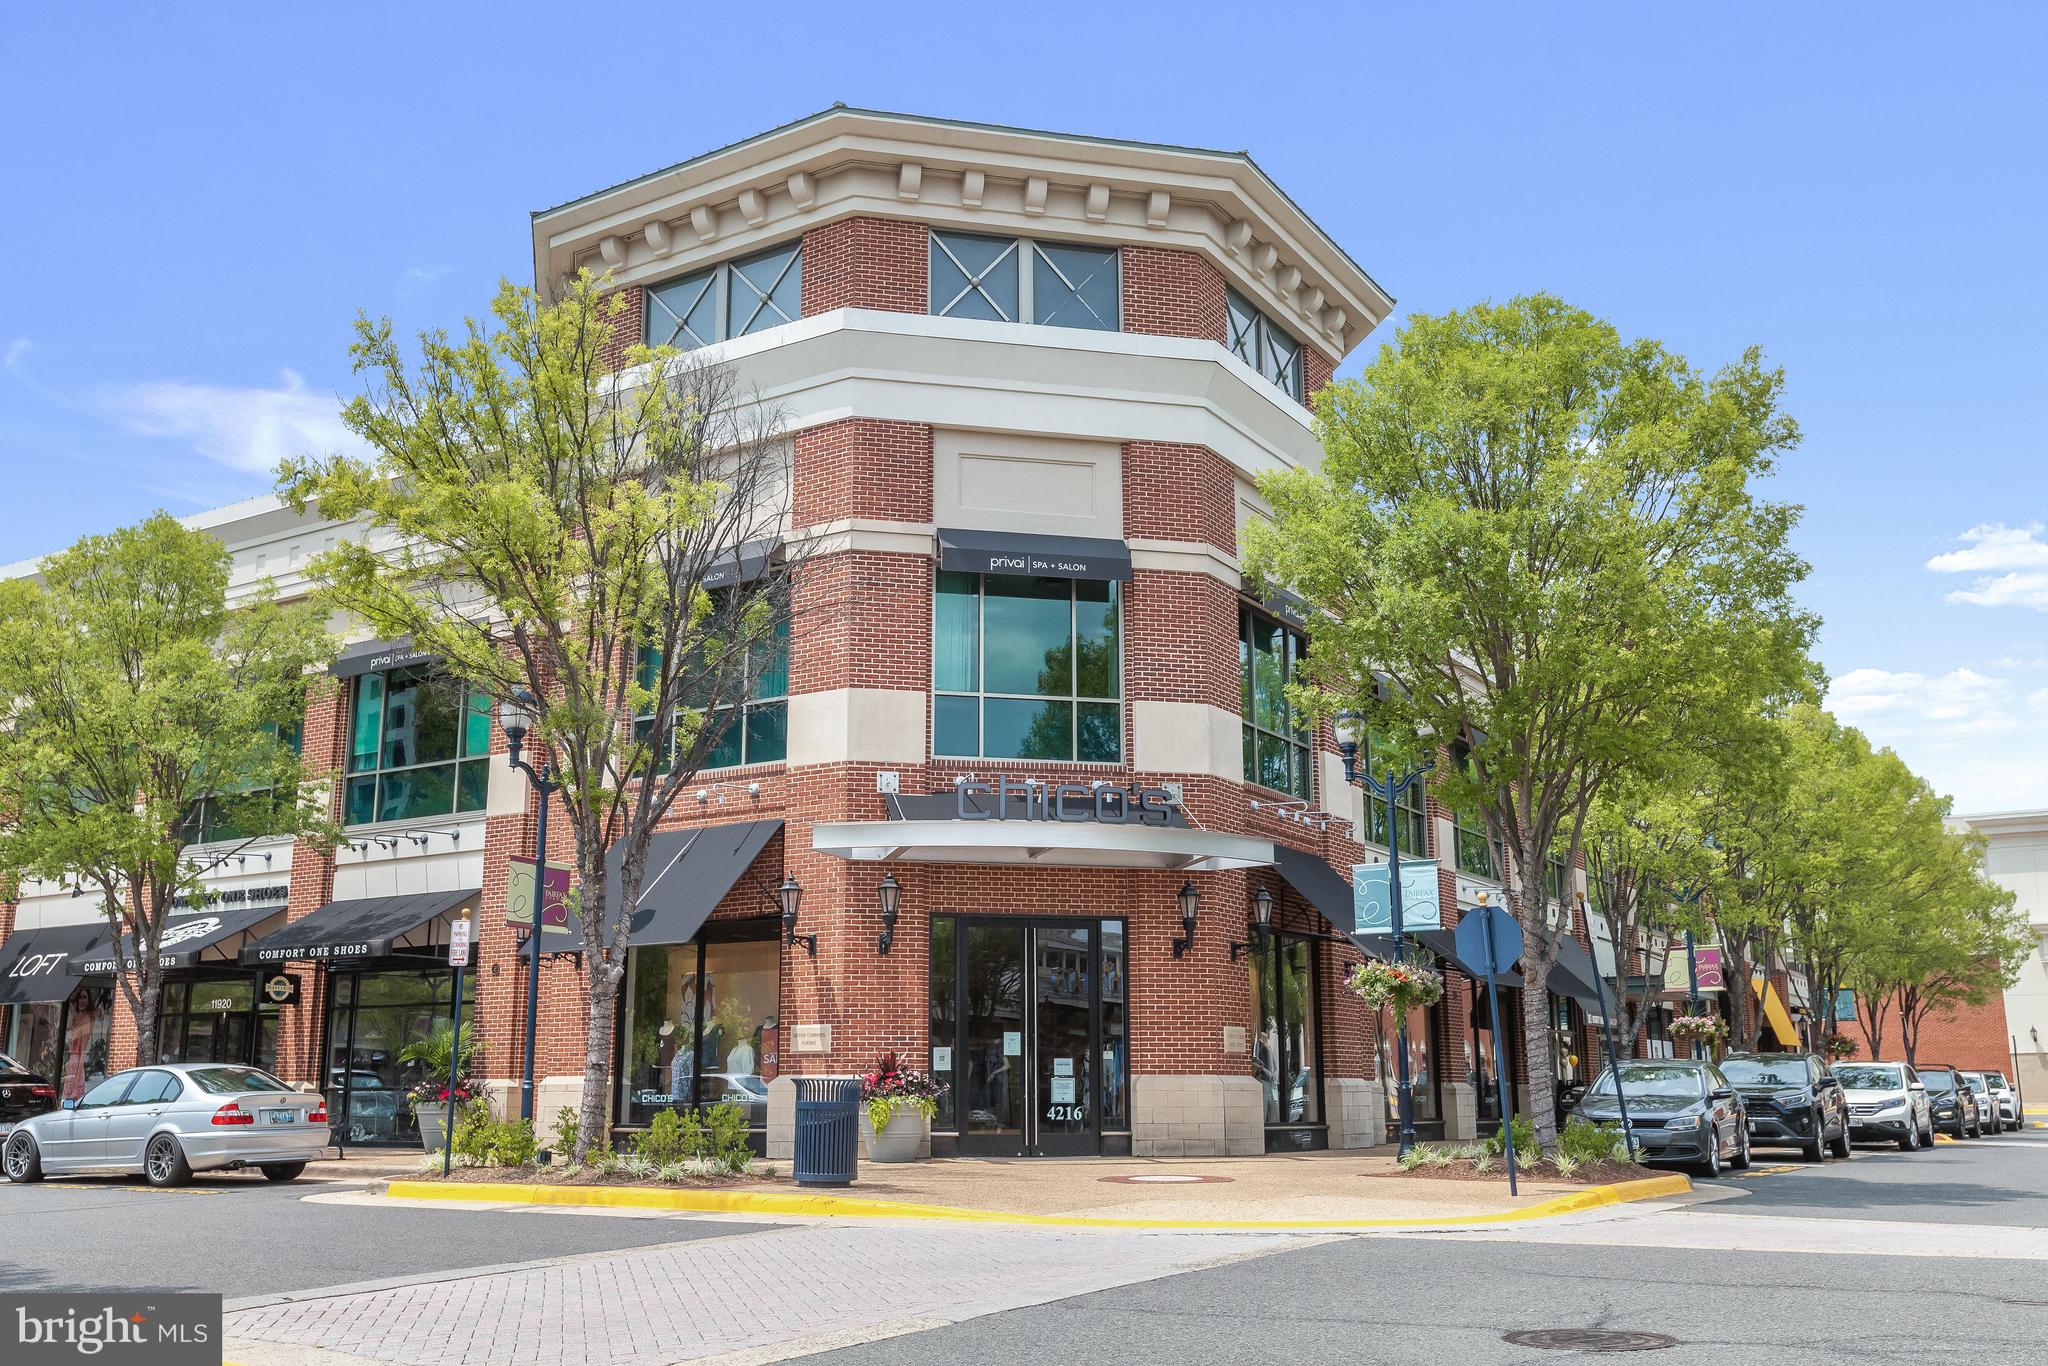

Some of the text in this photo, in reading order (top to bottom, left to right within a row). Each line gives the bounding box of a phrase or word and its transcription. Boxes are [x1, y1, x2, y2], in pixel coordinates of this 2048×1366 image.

[990, 555, 1025, 571] privai
[1032, 561, 1048, 569] SPA
[1058, 562, 1087, 572] SALON
[702, 571, 725, 583] SALON
[370, 653, 391, 670] privai
[221, 889, 246, 903] ONE
[247, 885, 288, 902] SHOES
[545, 890, 567, 898] FAIRFAX
[1405, 889, 1434, 898] FAIRFAX
[259, 944, 368, 960] COMFORT ONE SHOES
[8, 952, 69, 978] LOFT
[84, 963, 117, 972] COMFO
[211, 998, 232, 1009] 11920
[642, 1093, 673, 1103] CHICO'S
[1046, 1106, 1083, 1121] 4216
